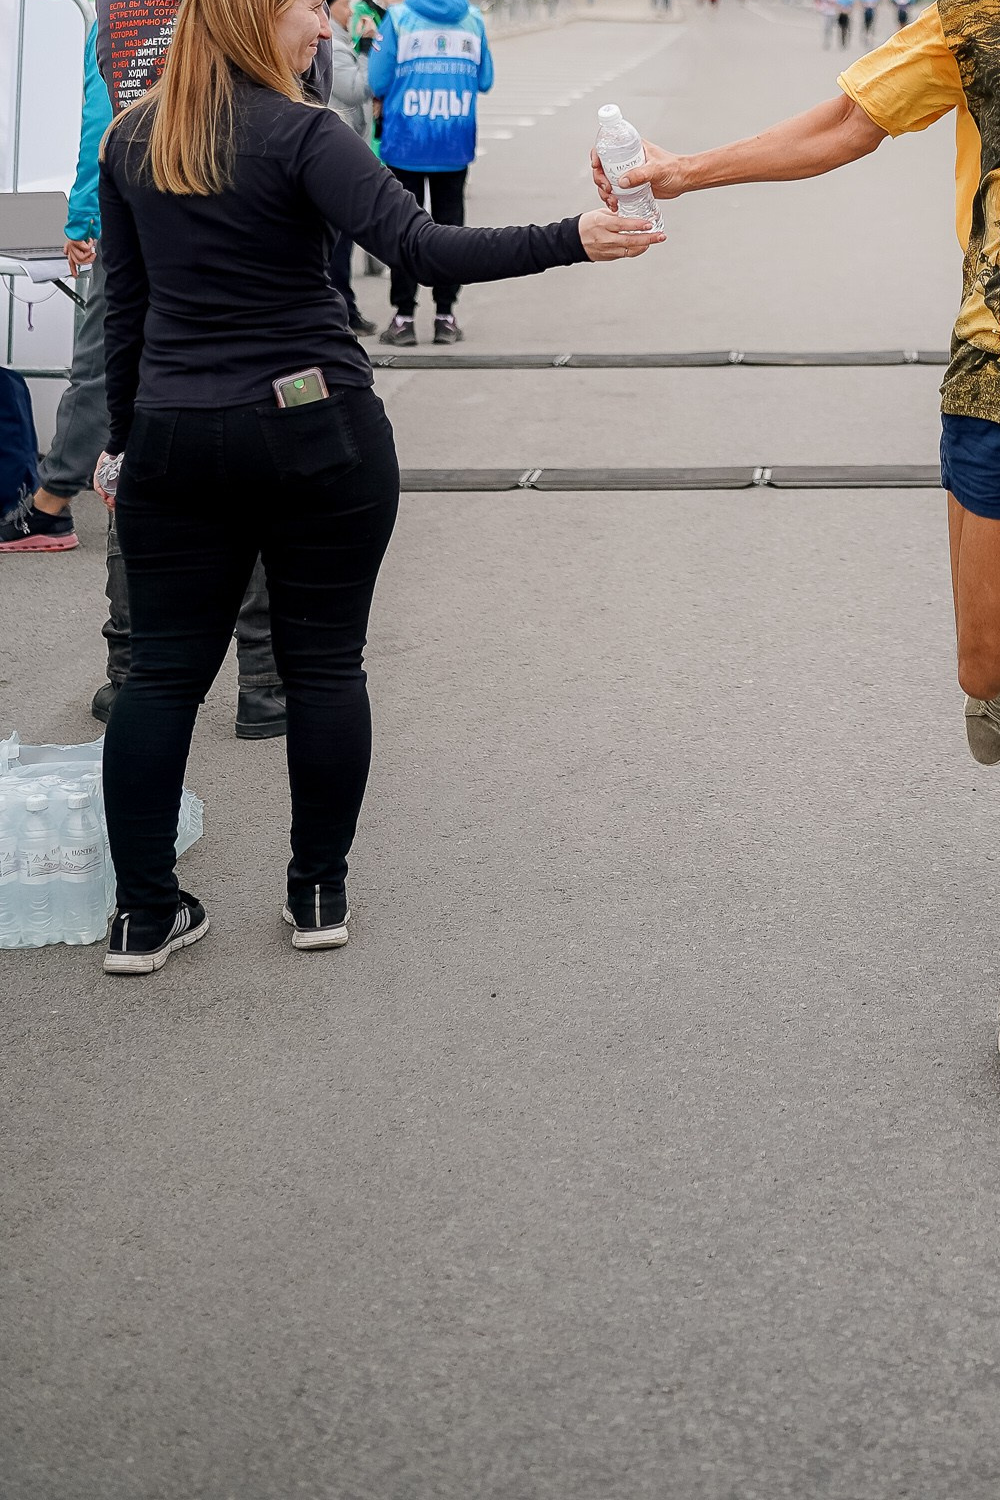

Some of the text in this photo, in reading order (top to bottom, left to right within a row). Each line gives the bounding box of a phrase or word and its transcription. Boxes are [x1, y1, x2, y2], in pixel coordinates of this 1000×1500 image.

[110, 2, 126, 10] ЕСЛИ
[110, 9, 149, 19] ВСТРЕТИЛИ
[116, 18, 161, 29] ДИНАМИЧНО
[111, 29, 138, 39] КОТОРАЯ
[131, 59, 136, 67] Я
